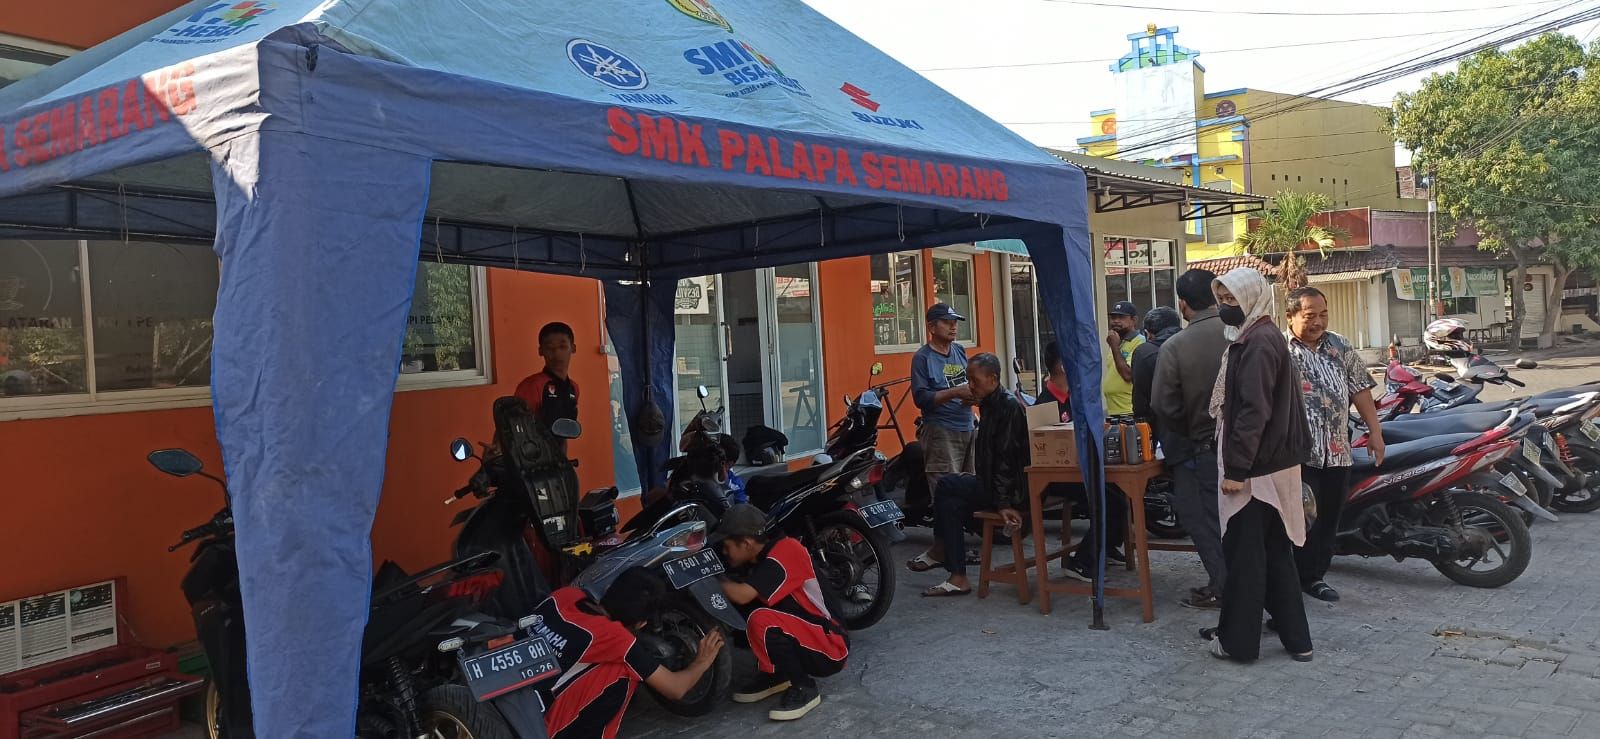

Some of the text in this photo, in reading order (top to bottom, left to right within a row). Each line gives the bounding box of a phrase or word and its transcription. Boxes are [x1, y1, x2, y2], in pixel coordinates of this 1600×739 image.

[723, 64, 770, 86] BISA
[609, 93, 679, 105] YAMAHA
[14, 62, 197, 168] SEMARANG
[851, 111, 925, 130] SUZUKI
[607, 107, 1009, 202] SMK PALAPA SEMARANG
[0, 316, 73, 329] ATARAN
[665, 550, 716, 576] H 2601 NY
[471, 662, 484, 679] H
[491, 650, 523, 672] 4556
